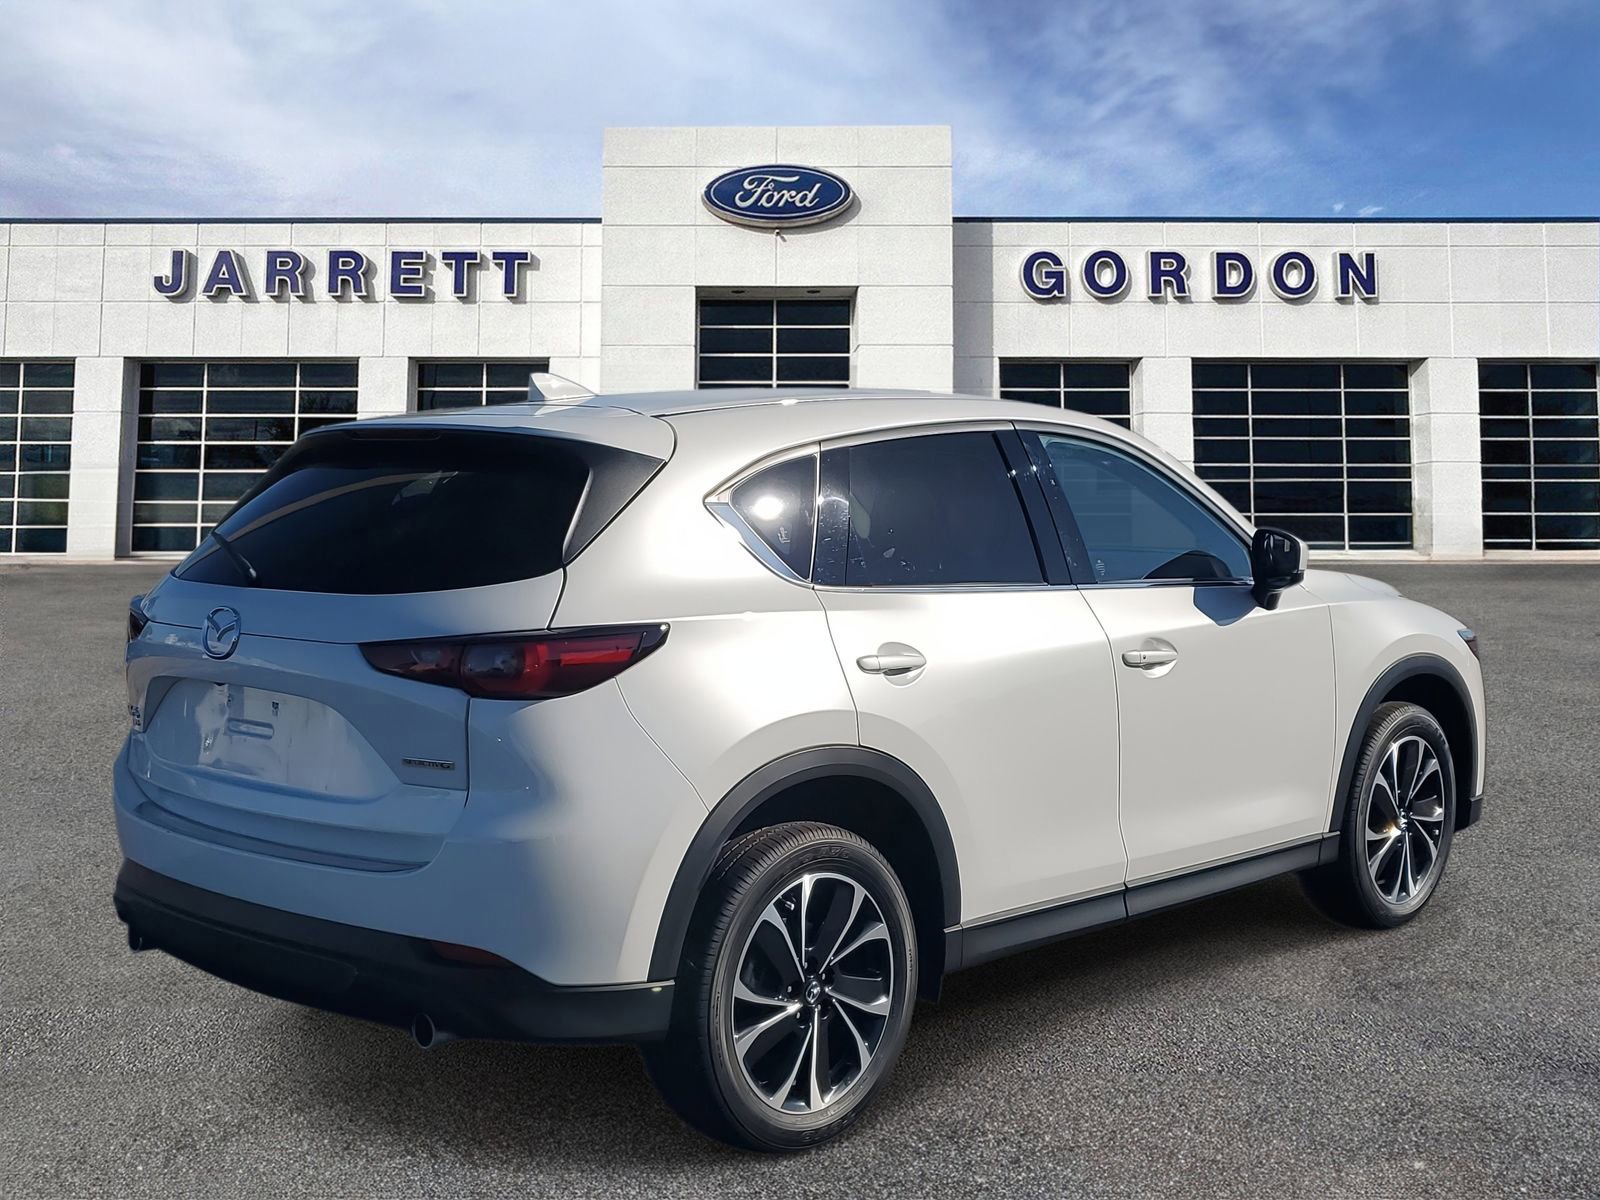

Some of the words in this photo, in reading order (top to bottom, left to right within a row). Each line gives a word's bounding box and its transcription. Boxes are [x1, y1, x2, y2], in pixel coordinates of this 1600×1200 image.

[735, 174, 822, 208] Ford
[153, 248, 532, 298] JARRETT
[1020, 249, 1379, 299] GORDON
